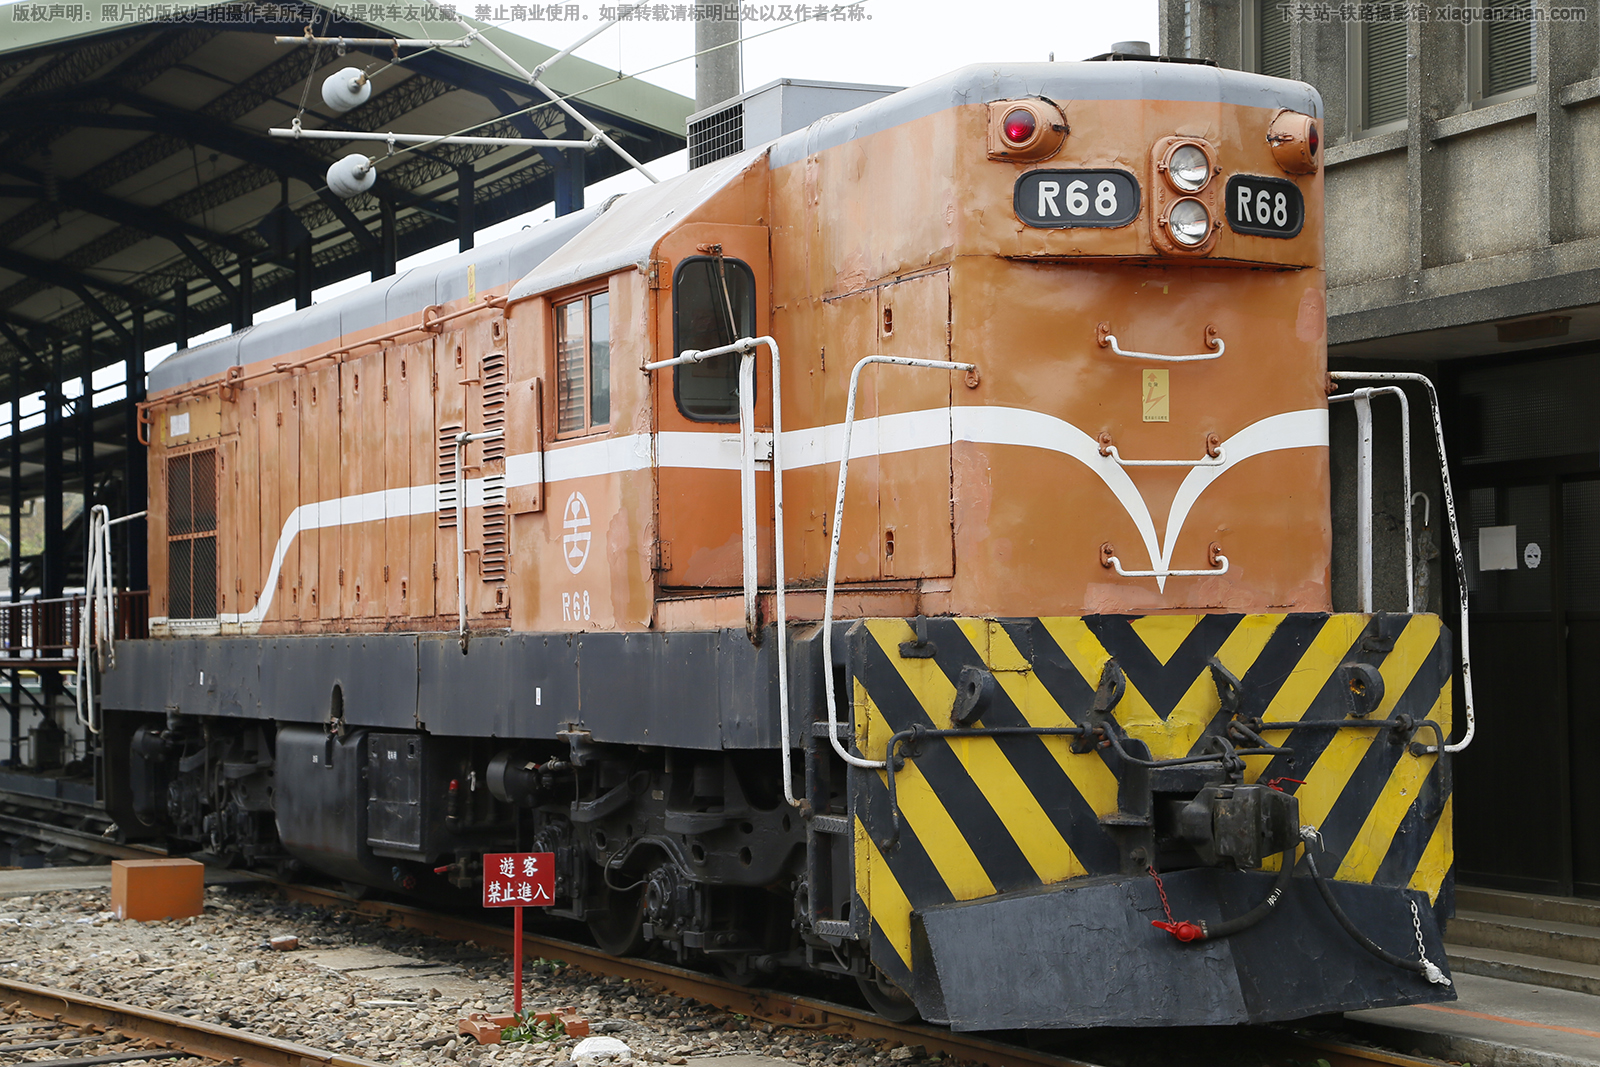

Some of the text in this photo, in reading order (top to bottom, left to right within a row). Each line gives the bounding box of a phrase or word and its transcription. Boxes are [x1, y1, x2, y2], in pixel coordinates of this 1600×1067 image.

[1038, 180, 1118, 217] R68
[1237, 185, 1288, 227] R68
[562, 590, 591, 621] R68
[499, 856, 539, 878] 遊客
[487, 880, 550, 904] 禁止進入
